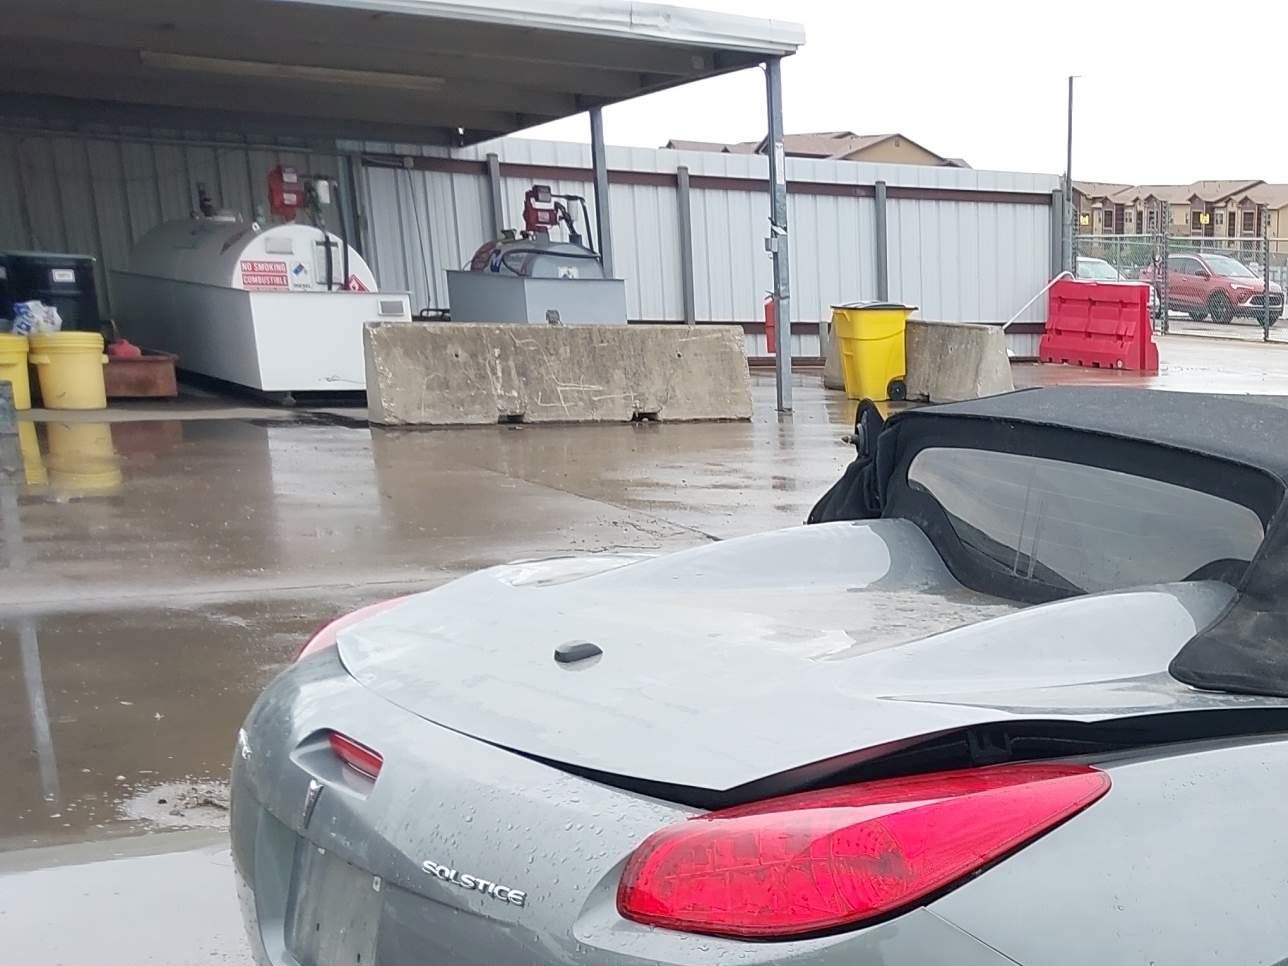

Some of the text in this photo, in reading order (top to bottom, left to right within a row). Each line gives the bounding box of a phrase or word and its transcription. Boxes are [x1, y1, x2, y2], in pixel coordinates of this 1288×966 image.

[242, 262, 286, 273] NO SMOKING
[421, 860, 526, 906] SOLSTICE
